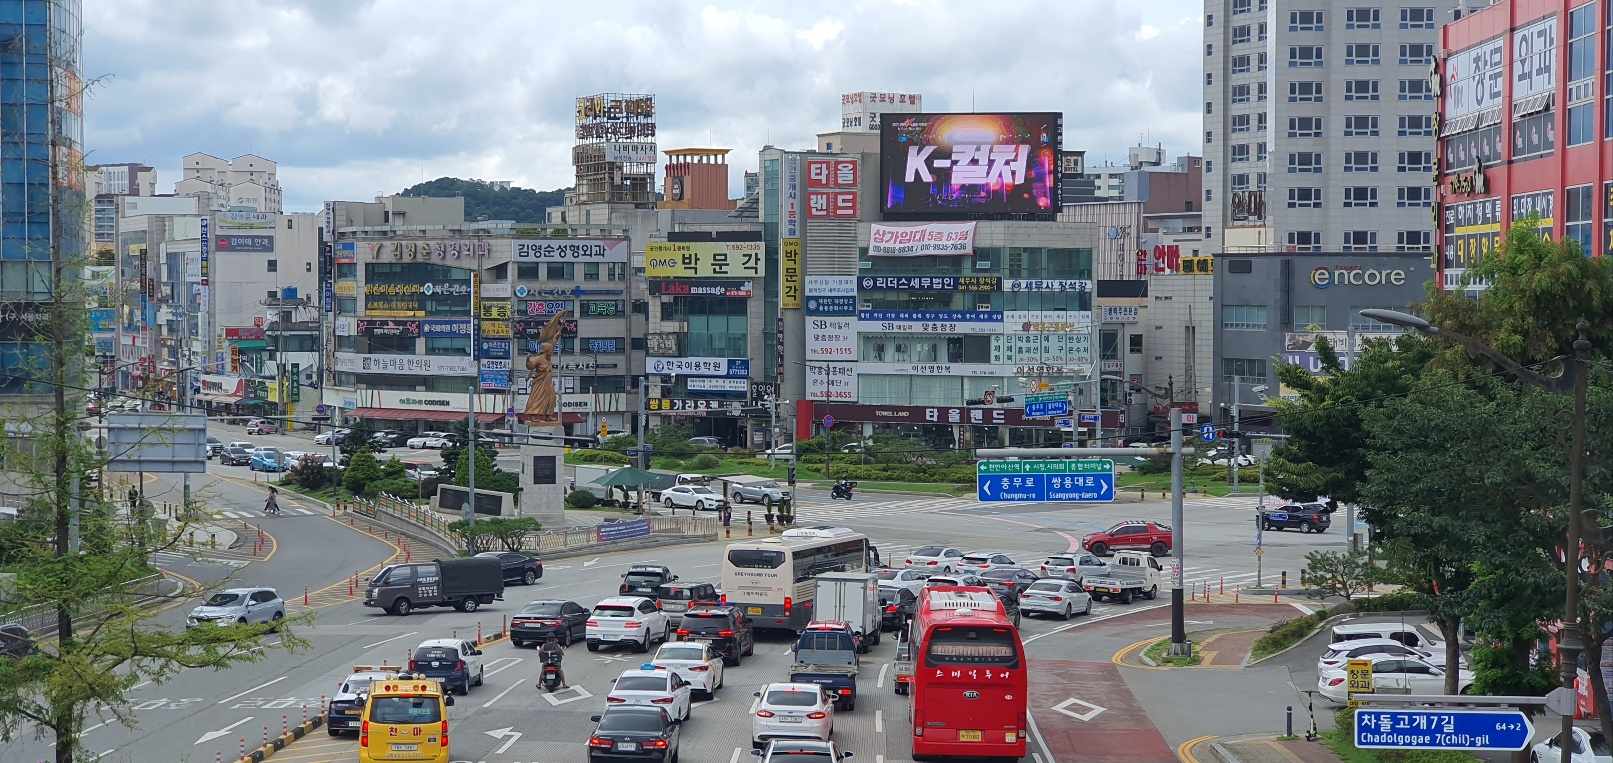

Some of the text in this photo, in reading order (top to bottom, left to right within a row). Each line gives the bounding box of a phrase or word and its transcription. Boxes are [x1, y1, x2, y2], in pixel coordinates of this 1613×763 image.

[1472, 24, 1554, 106] 창문 외과
[905, 144, 1031, 184] K-컬처
[810, 194, 854, 216] 랜드
[518, 243, 607, 258] 김영순성형외과
[681, 252, 761, 275] 박문각
[785, 249, 799, 301] 박문각
[1311, 267, 1406, 286] encore
[690, 285, 725, 295] massage
[876, 277, 954, 289] 리더스세무법인
[812, 320, 828, 330] SB
[881, 322, 895, 331] SB
[373, 358, 432, 371] 하늘마음 한의원
[666, 360, 721, 372] 한국이용학원
[1000, 477, 1036, 490] 충무로
[1051, 476, 1095, 489] 쌍용대로
[1361, 714, 1455, 732] 차돌고개7길
[1361, 732, 1490, 746] Chadolgogae 7(chil)-gil
